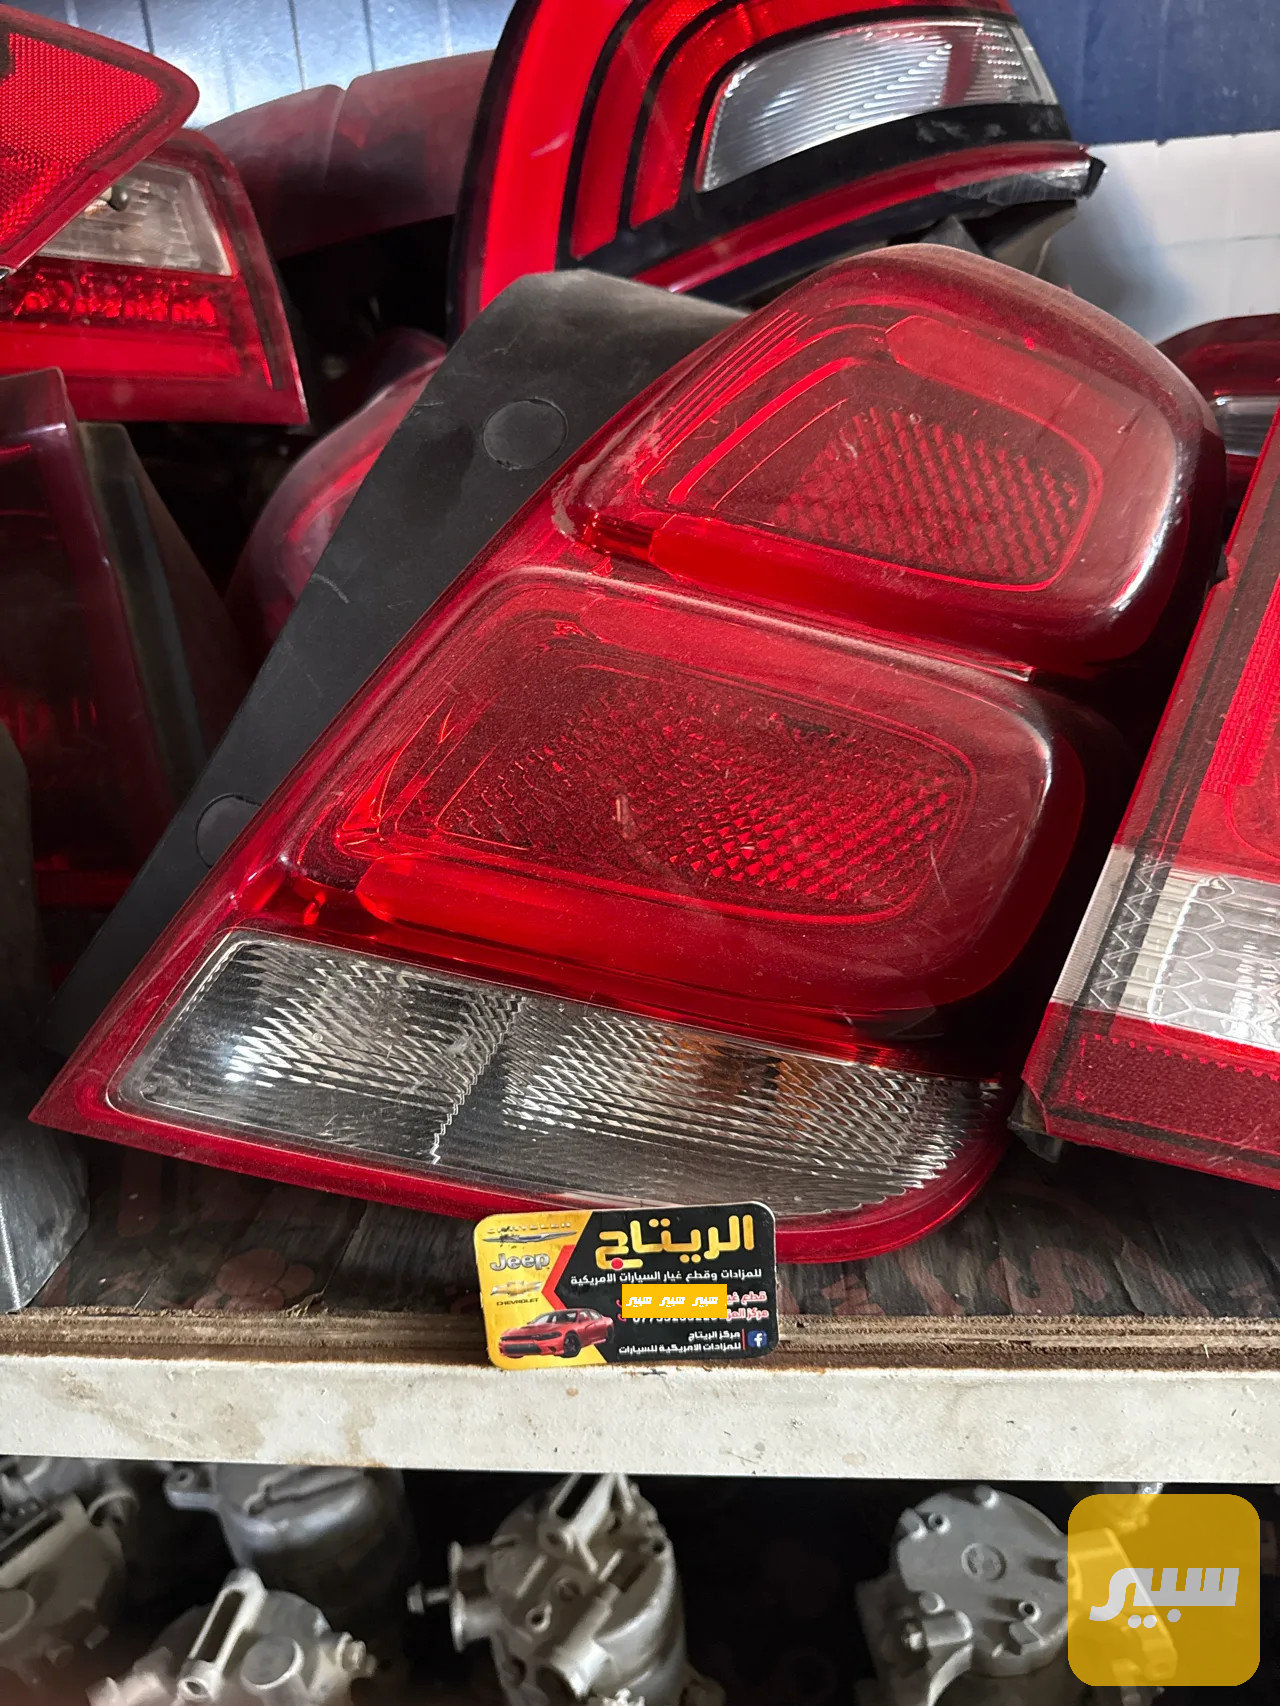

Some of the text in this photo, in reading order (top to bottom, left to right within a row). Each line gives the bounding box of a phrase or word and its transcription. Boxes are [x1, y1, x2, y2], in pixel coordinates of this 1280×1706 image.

[595, 1214, 755, 1271] الريتاج
[490, 1253, 550, 1271] Jeep
[619, 1271, 661, 1283] السيارات
[663, 1270, 682, 1282] غيار
[685, 1271, 718, 1283] وقطع
[720, 1268, 762, 1281] للمزادات
[496, 1298, 539, 1306] CHEVROLET
[741, 1290, 768, 1306] قطع
[688, 1330, 741, 1342] مركز الريتاج
